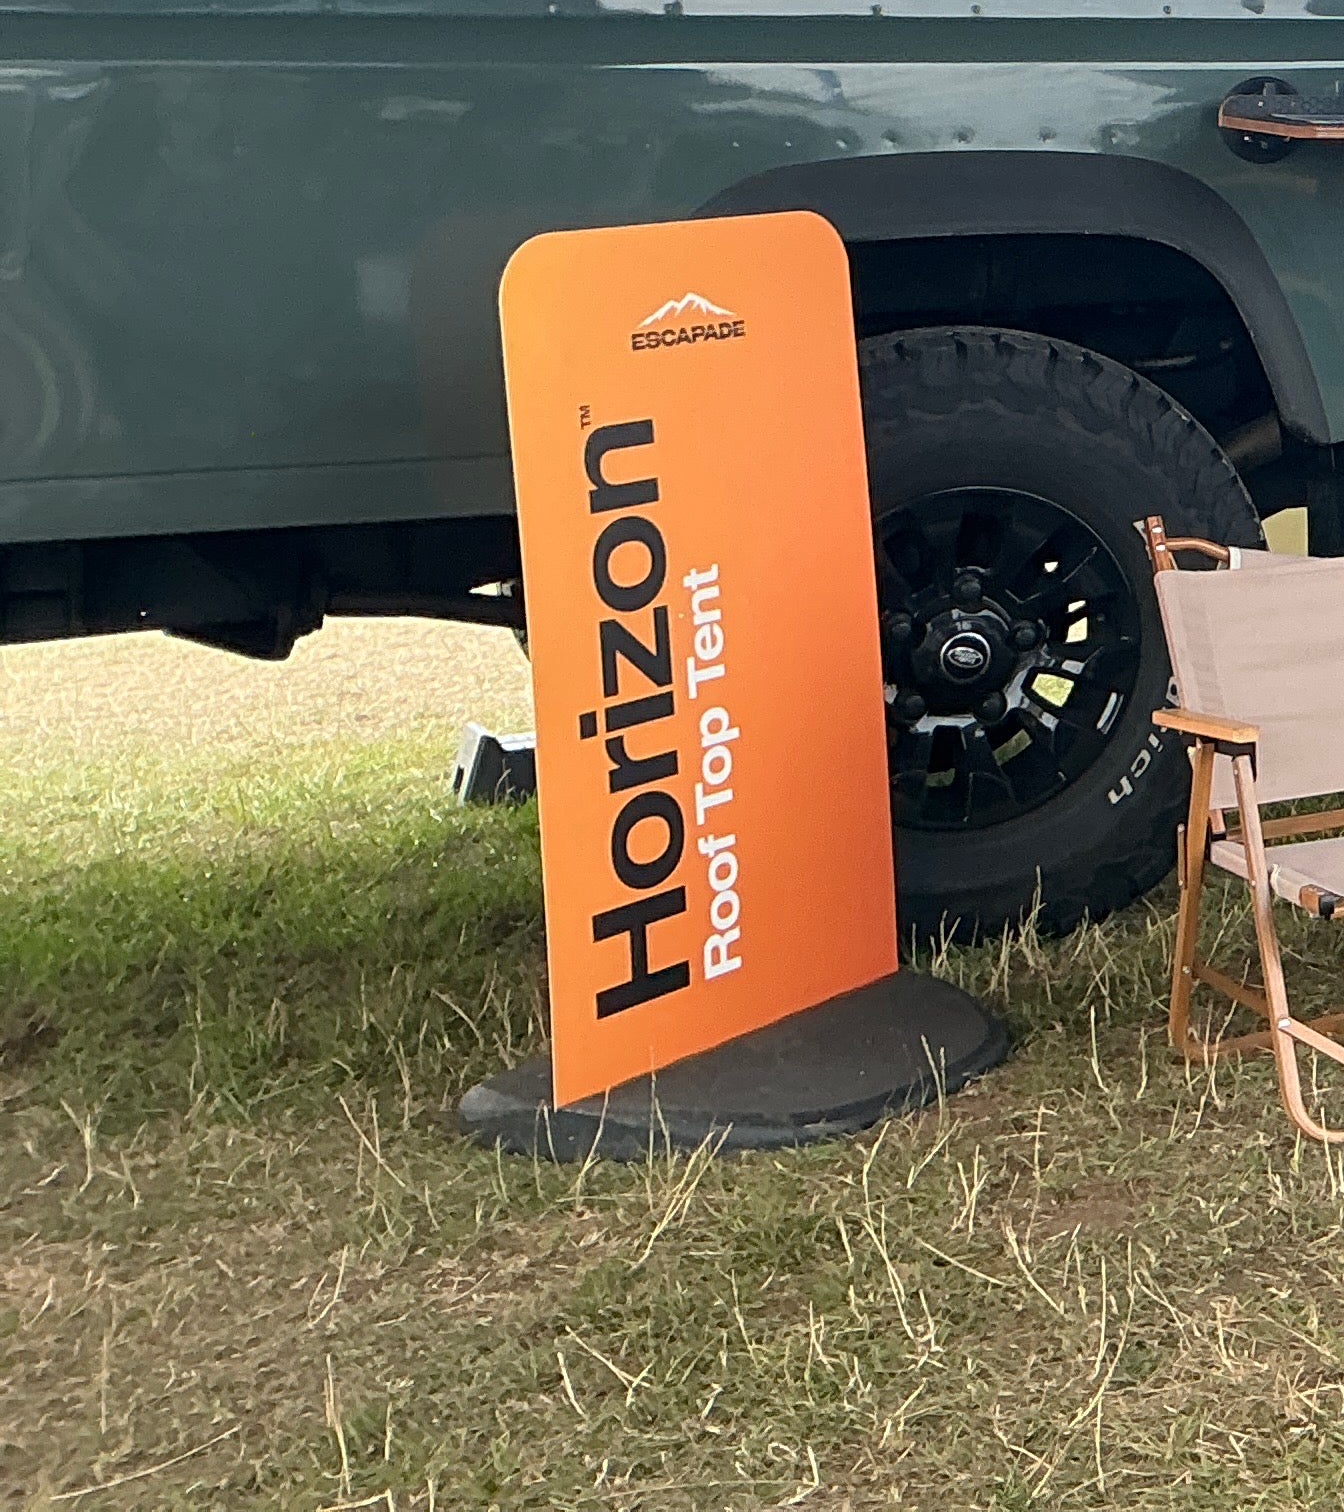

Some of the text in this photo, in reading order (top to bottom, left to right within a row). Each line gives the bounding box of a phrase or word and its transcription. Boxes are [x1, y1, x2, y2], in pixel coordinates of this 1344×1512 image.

[631, 319, 746, 351] ESCAPADE
[579, 418, 690, 1020] Horizon
[684, 563, 743, 980] Roof Top Tent
